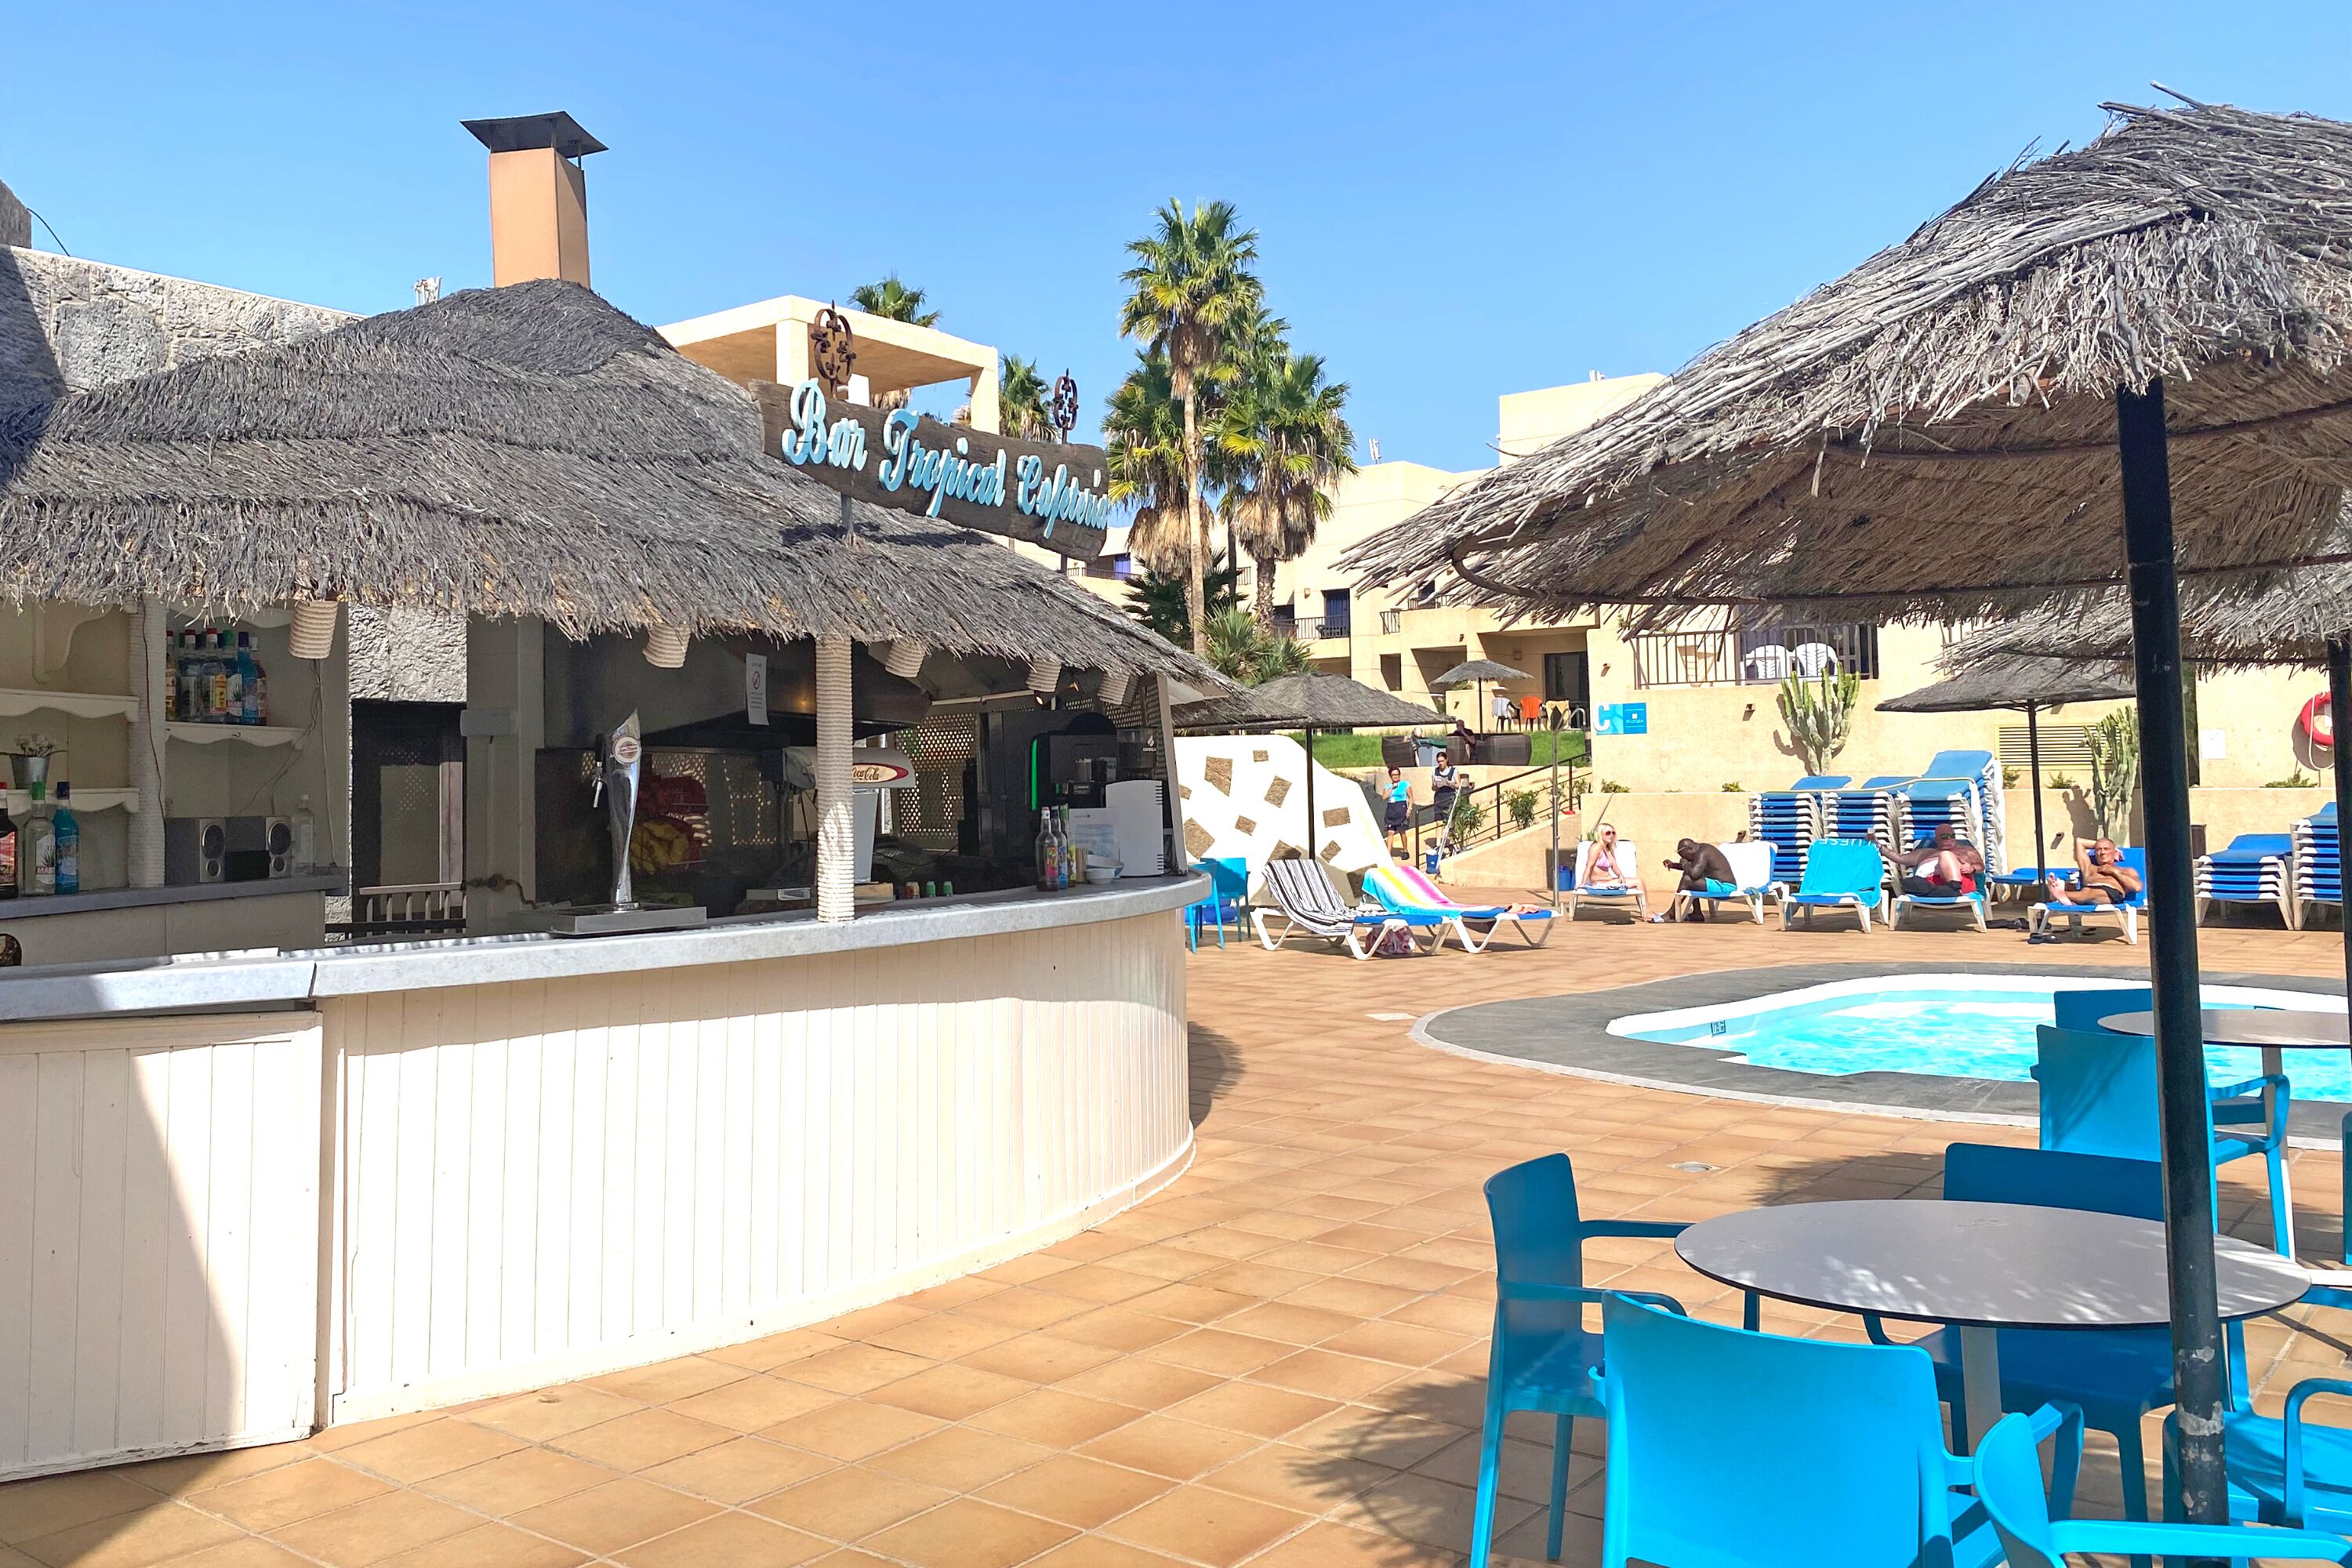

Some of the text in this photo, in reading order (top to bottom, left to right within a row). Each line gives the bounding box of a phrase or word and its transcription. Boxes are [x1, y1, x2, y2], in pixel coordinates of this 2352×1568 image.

[781, 377, 1109, 539] Bar Tropical Cafeteria
[1593, 702, 1610, 731] C
